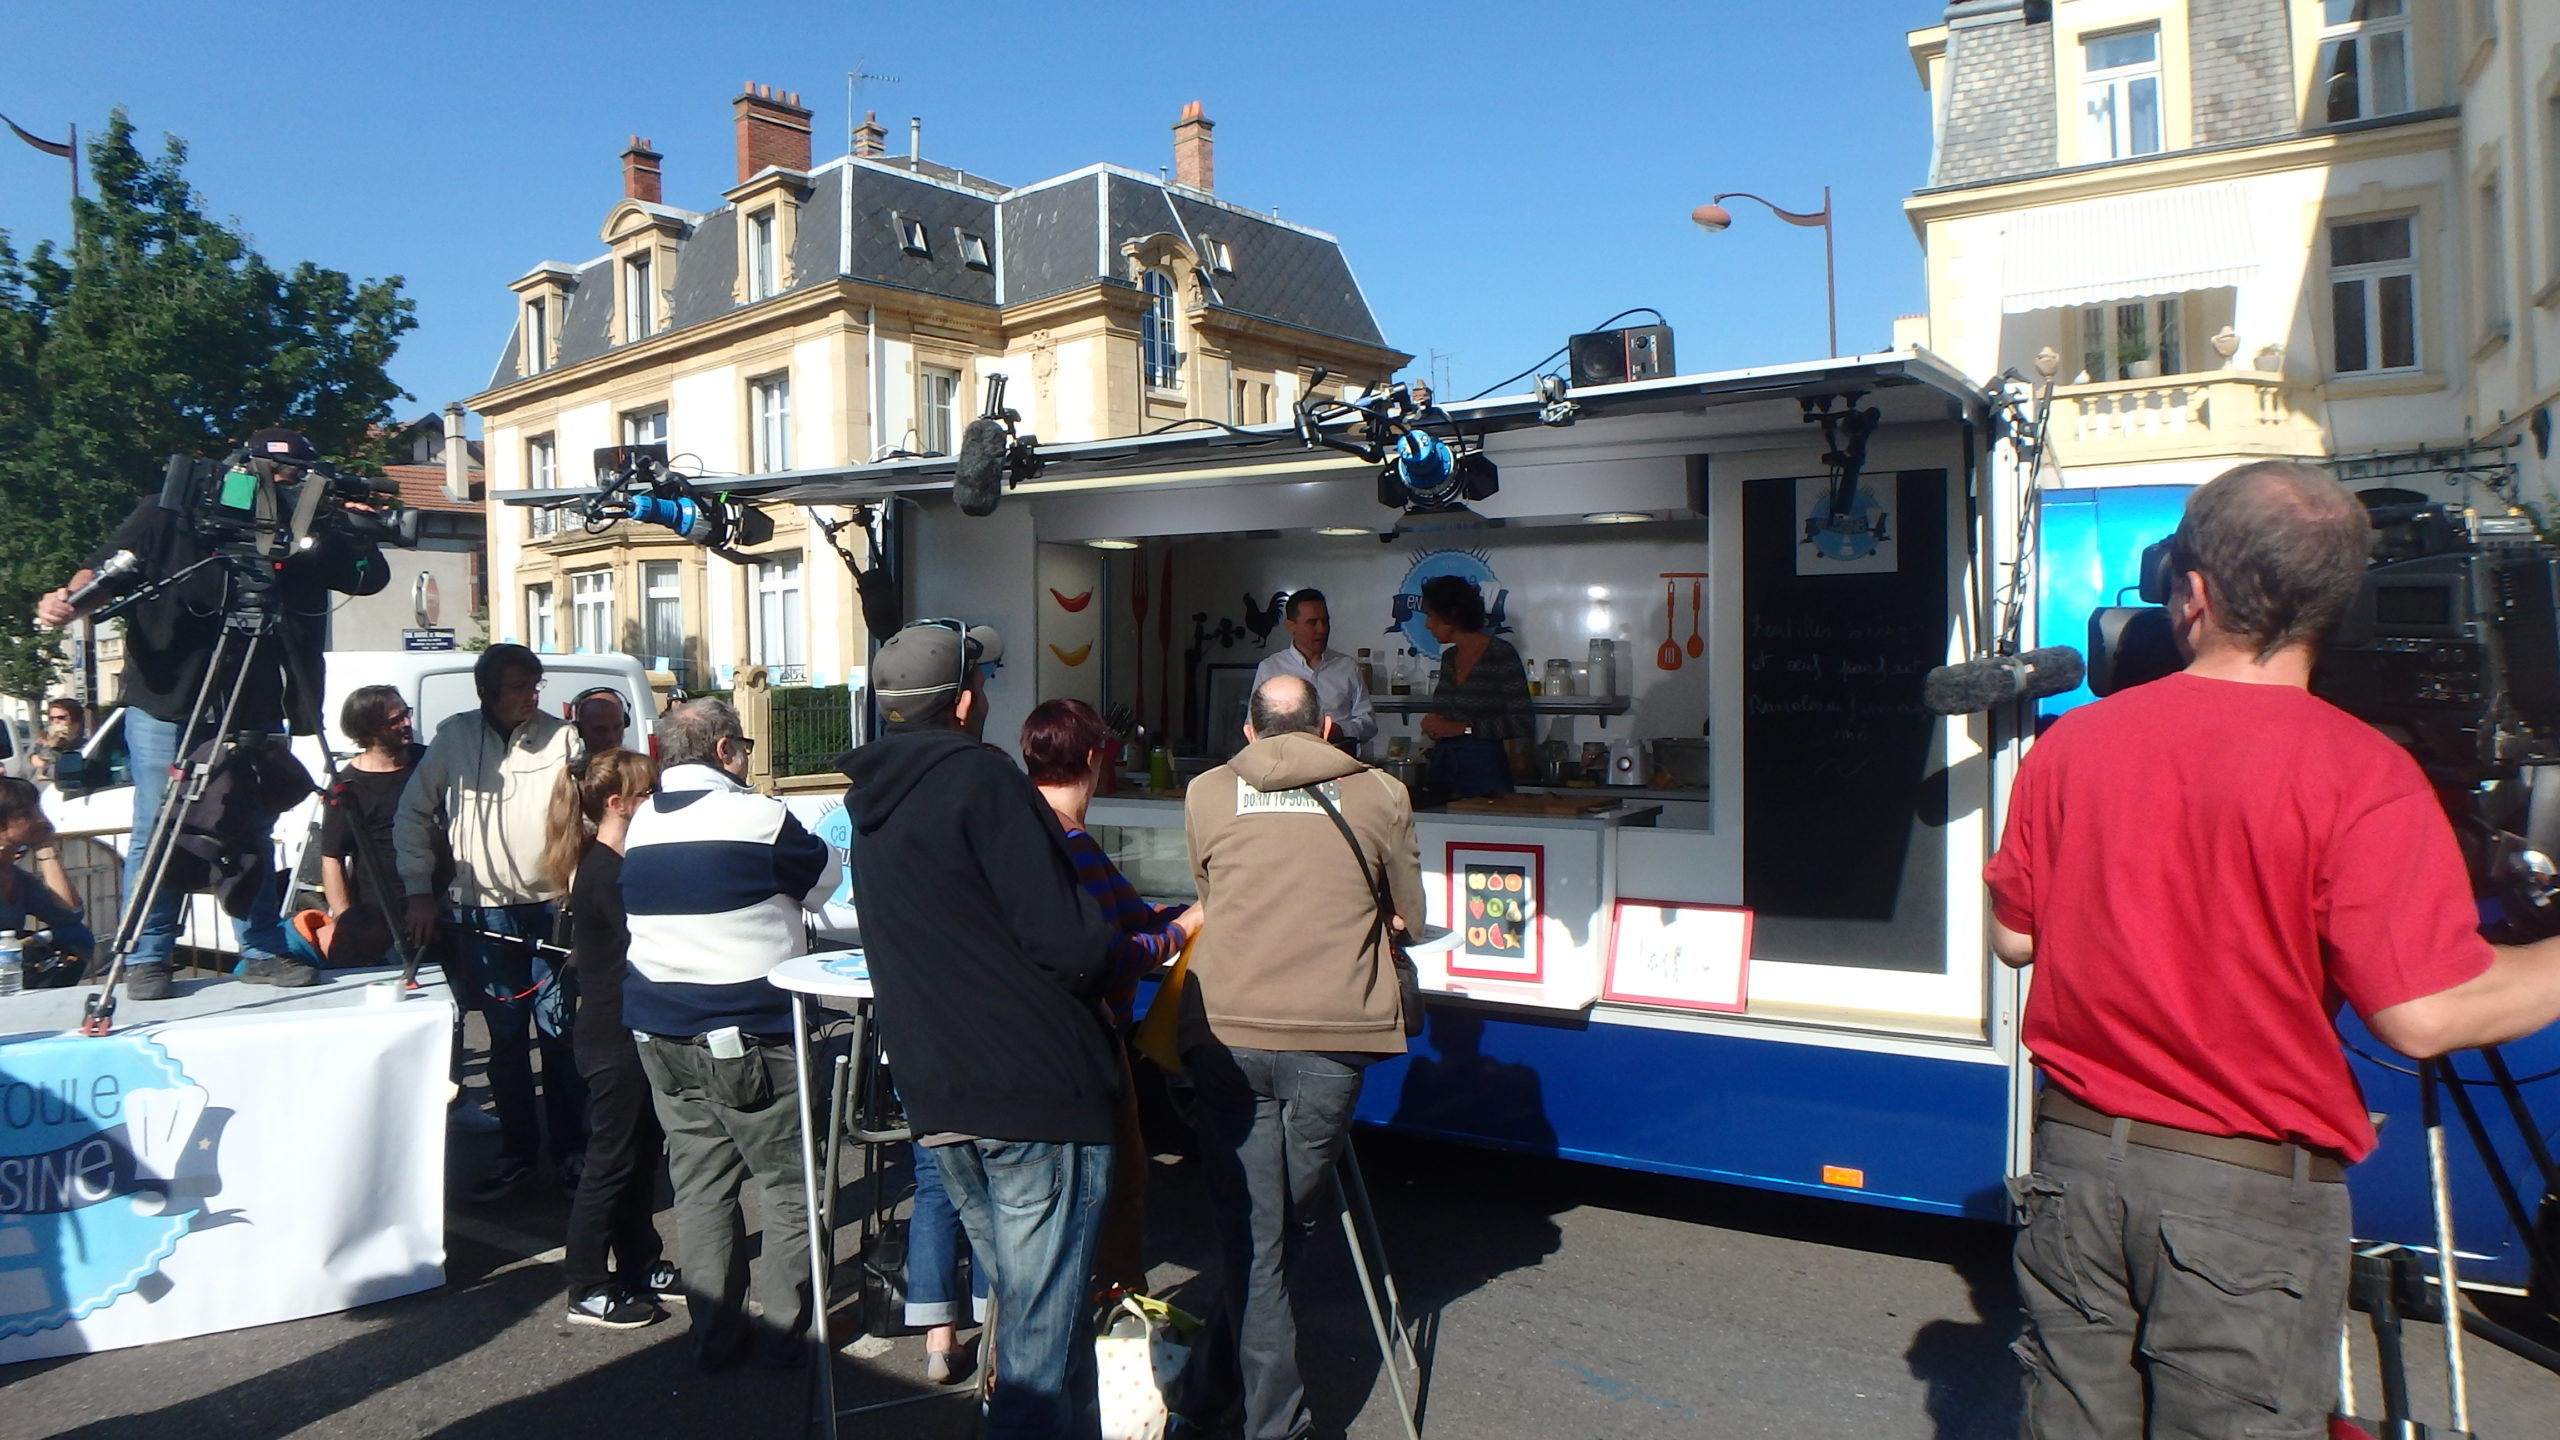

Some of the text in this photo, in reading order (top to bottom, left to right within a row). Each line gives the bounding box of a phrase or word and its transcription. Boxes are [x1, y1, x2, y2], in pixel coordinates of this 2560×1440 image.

[1244, 793, 1271, 808] BORN
[1274, 792, 1287, 807] TO
[831, 825, 847, 845] ça
[0, 1075, 121, 1129] OULe
